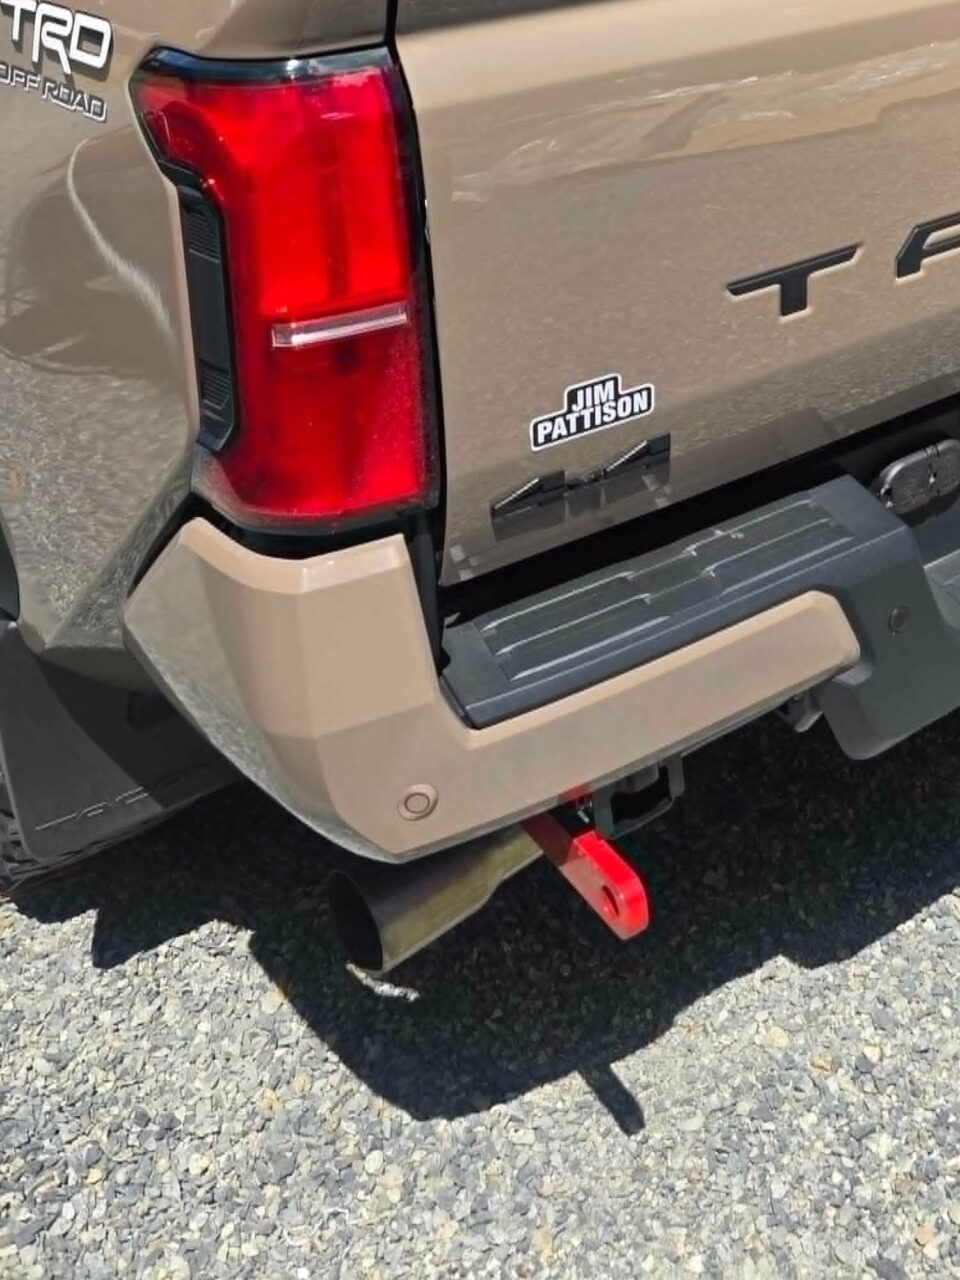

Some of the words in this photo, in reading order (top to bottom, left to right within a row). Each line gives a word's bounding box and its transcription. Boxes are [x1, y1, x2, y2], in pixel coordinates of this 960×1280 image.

[42, 77, 107, 122] ROAD
[536, 389, 649, 445] PATTISON
[571, 379, 615, 412] JIM
